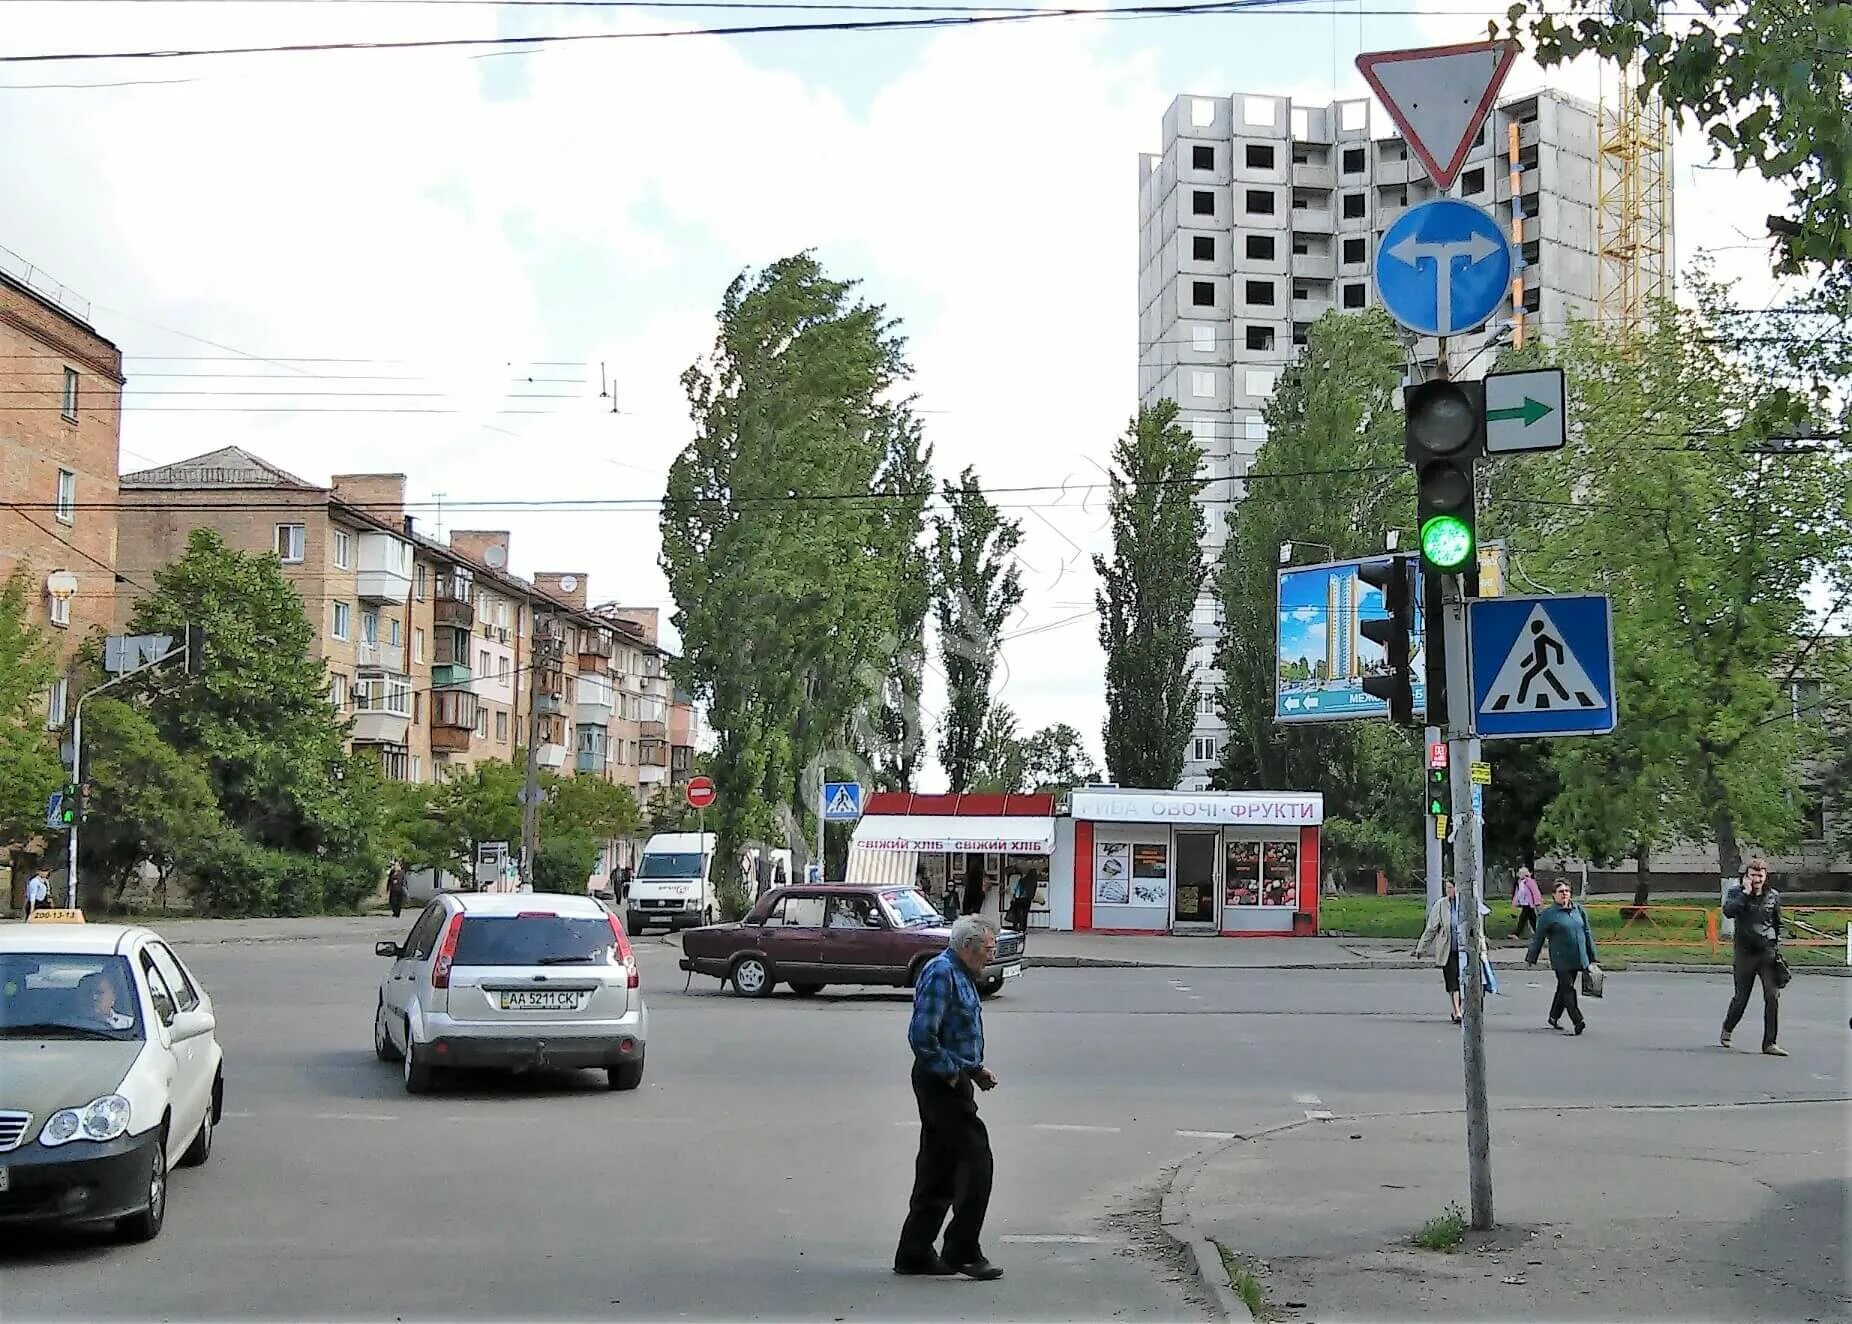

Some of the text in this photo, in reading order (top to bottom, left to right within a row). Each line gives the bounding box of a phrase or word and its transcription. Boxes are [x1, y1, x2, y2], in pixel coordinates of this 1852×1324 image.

[1151, 801, 1217, 817] ОВОЧІ
[1230, 803, 1315, 818] ФРУКТИ
[857, 839, 1041, 851] СВІЖИЙ ХЛІБ СВІЖИЙ ХЛІБ
[509, 993, 574, 1005] AA 5211 CK
